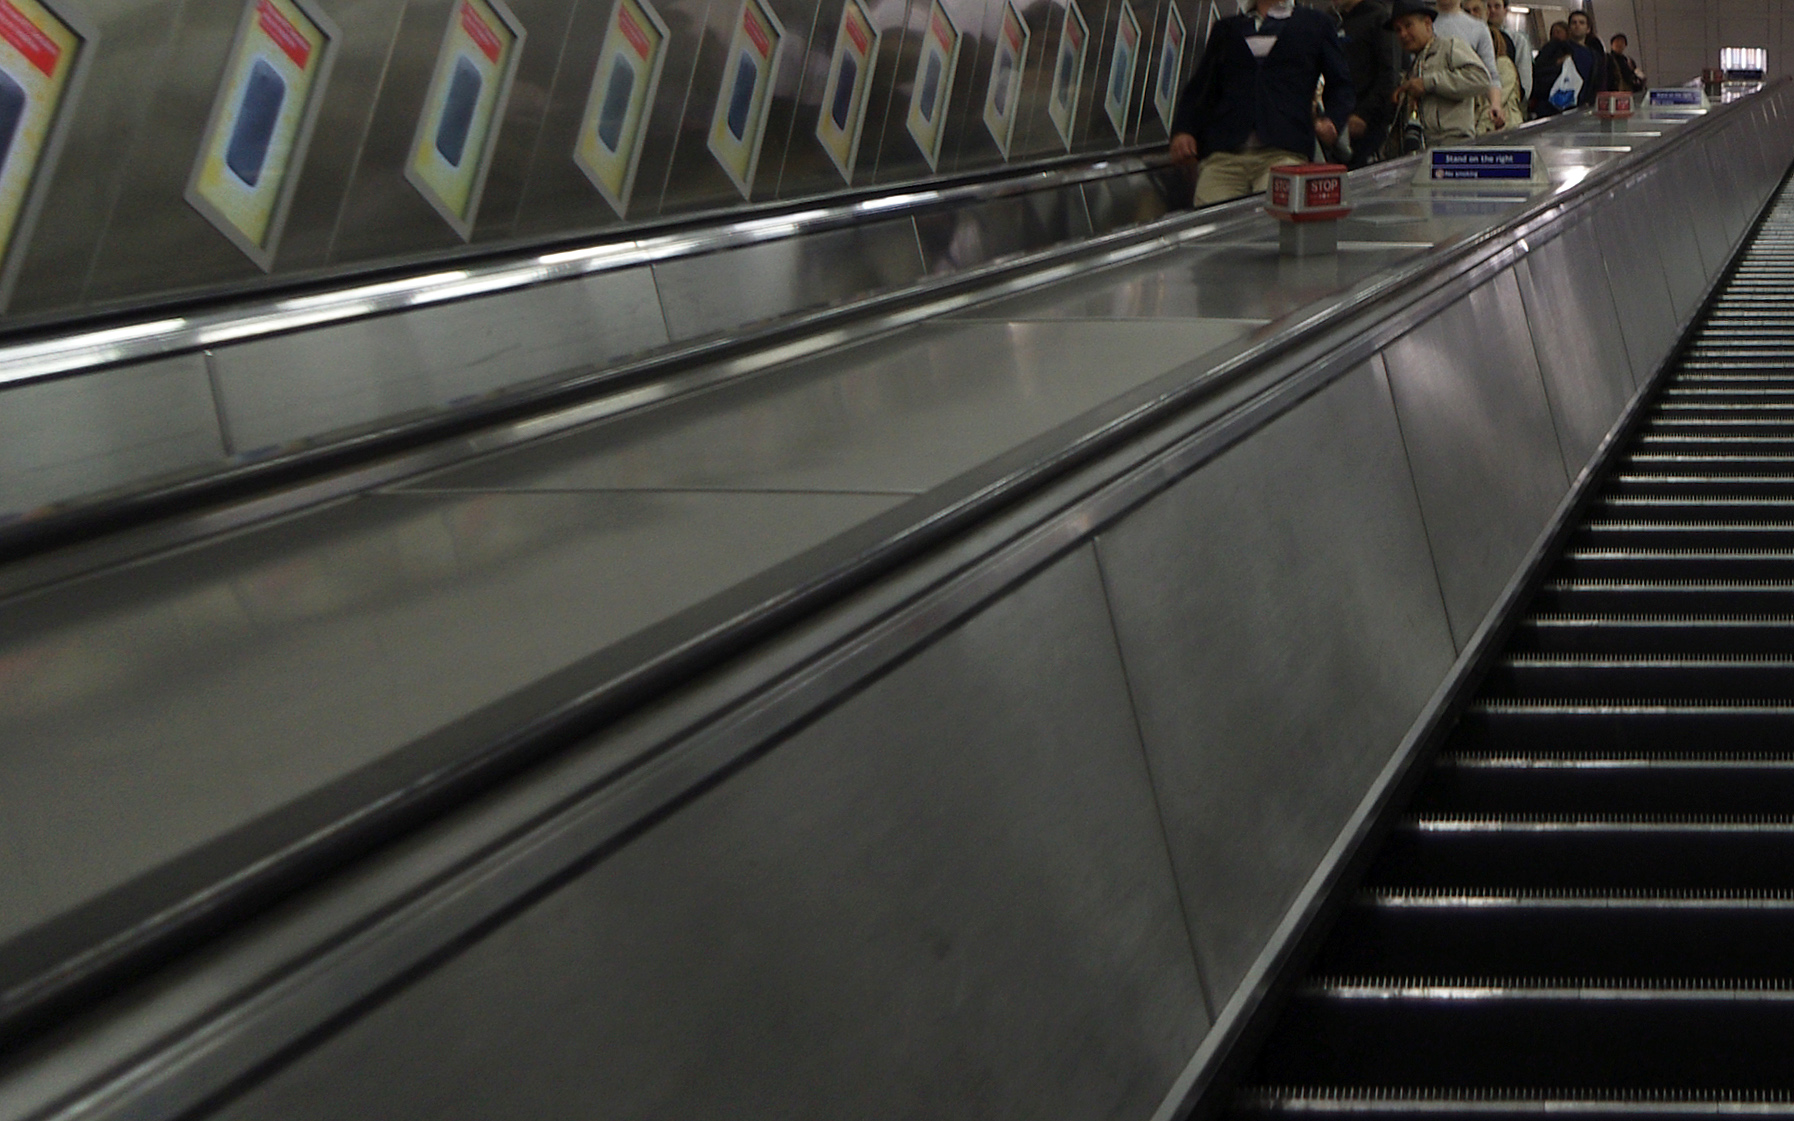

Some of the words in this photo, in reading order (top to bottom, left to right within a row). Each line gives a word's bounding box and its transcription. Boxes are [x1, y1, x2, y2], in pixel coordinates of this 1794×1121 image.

[1445, 154, 1468, 163] Stand
[1480, 154, 1494, 163] the
[1496, 154, 1513, 165] right
[1311, 179, 1338, 193] STOP
